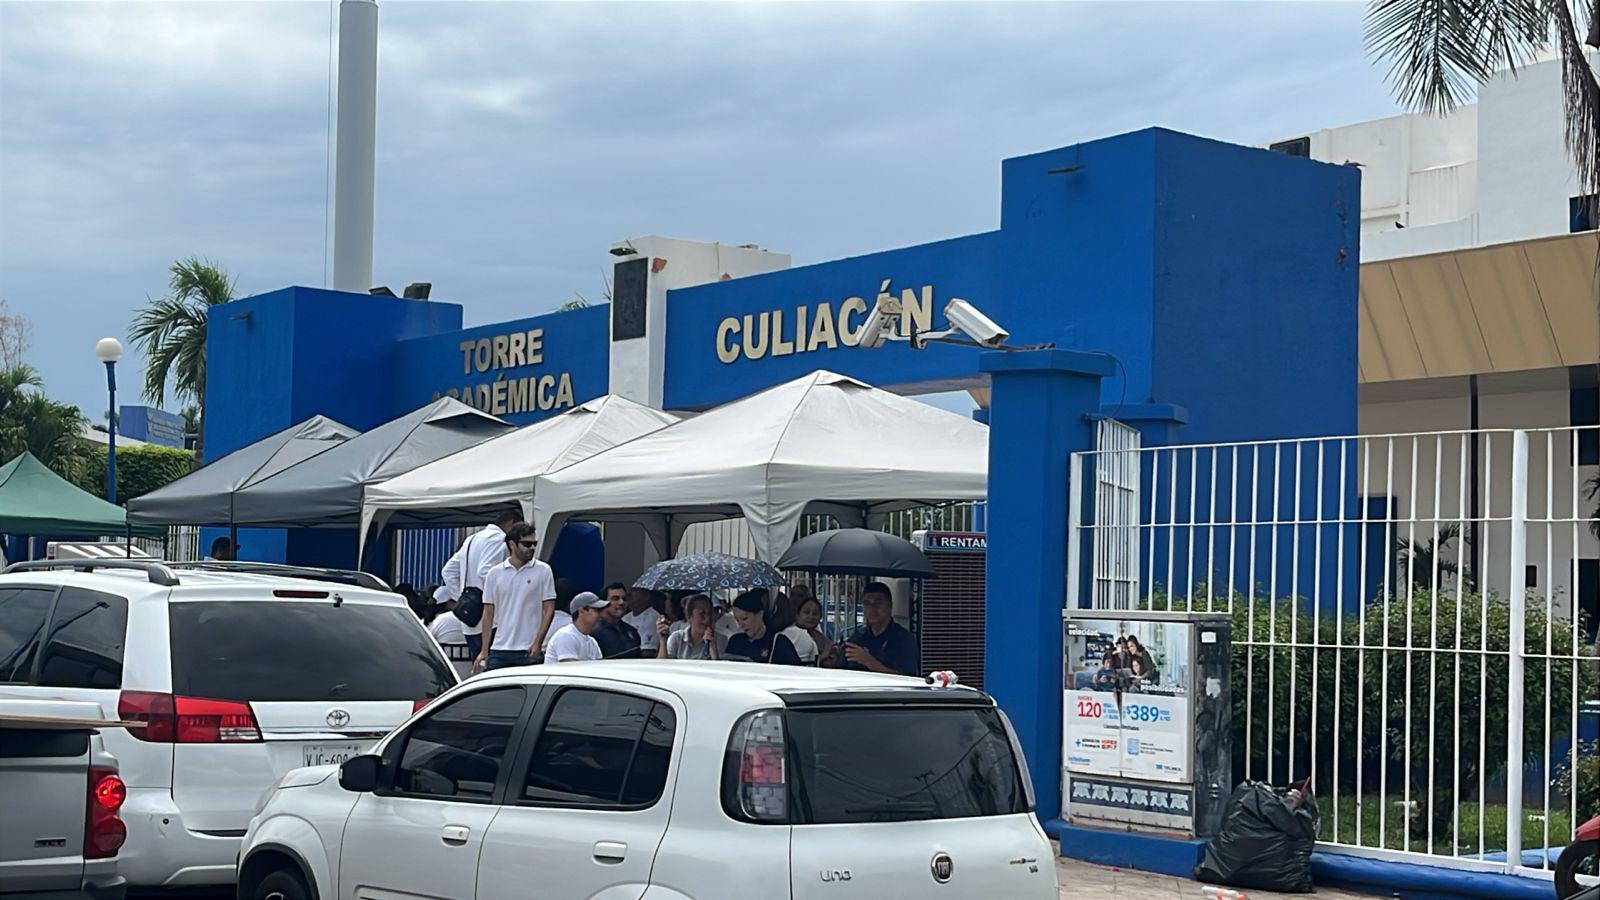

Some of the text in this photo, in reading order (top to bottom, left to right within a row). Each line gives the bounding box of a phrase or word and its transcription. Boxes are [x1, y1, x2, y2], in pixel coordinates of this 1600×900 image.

[460, 328, 544, 374] TORRE
[433, 372, 575, 416] ADÉMICA
[1078, 701, 1102, 718] 120
[1126, 704, 1159, 722] $389
